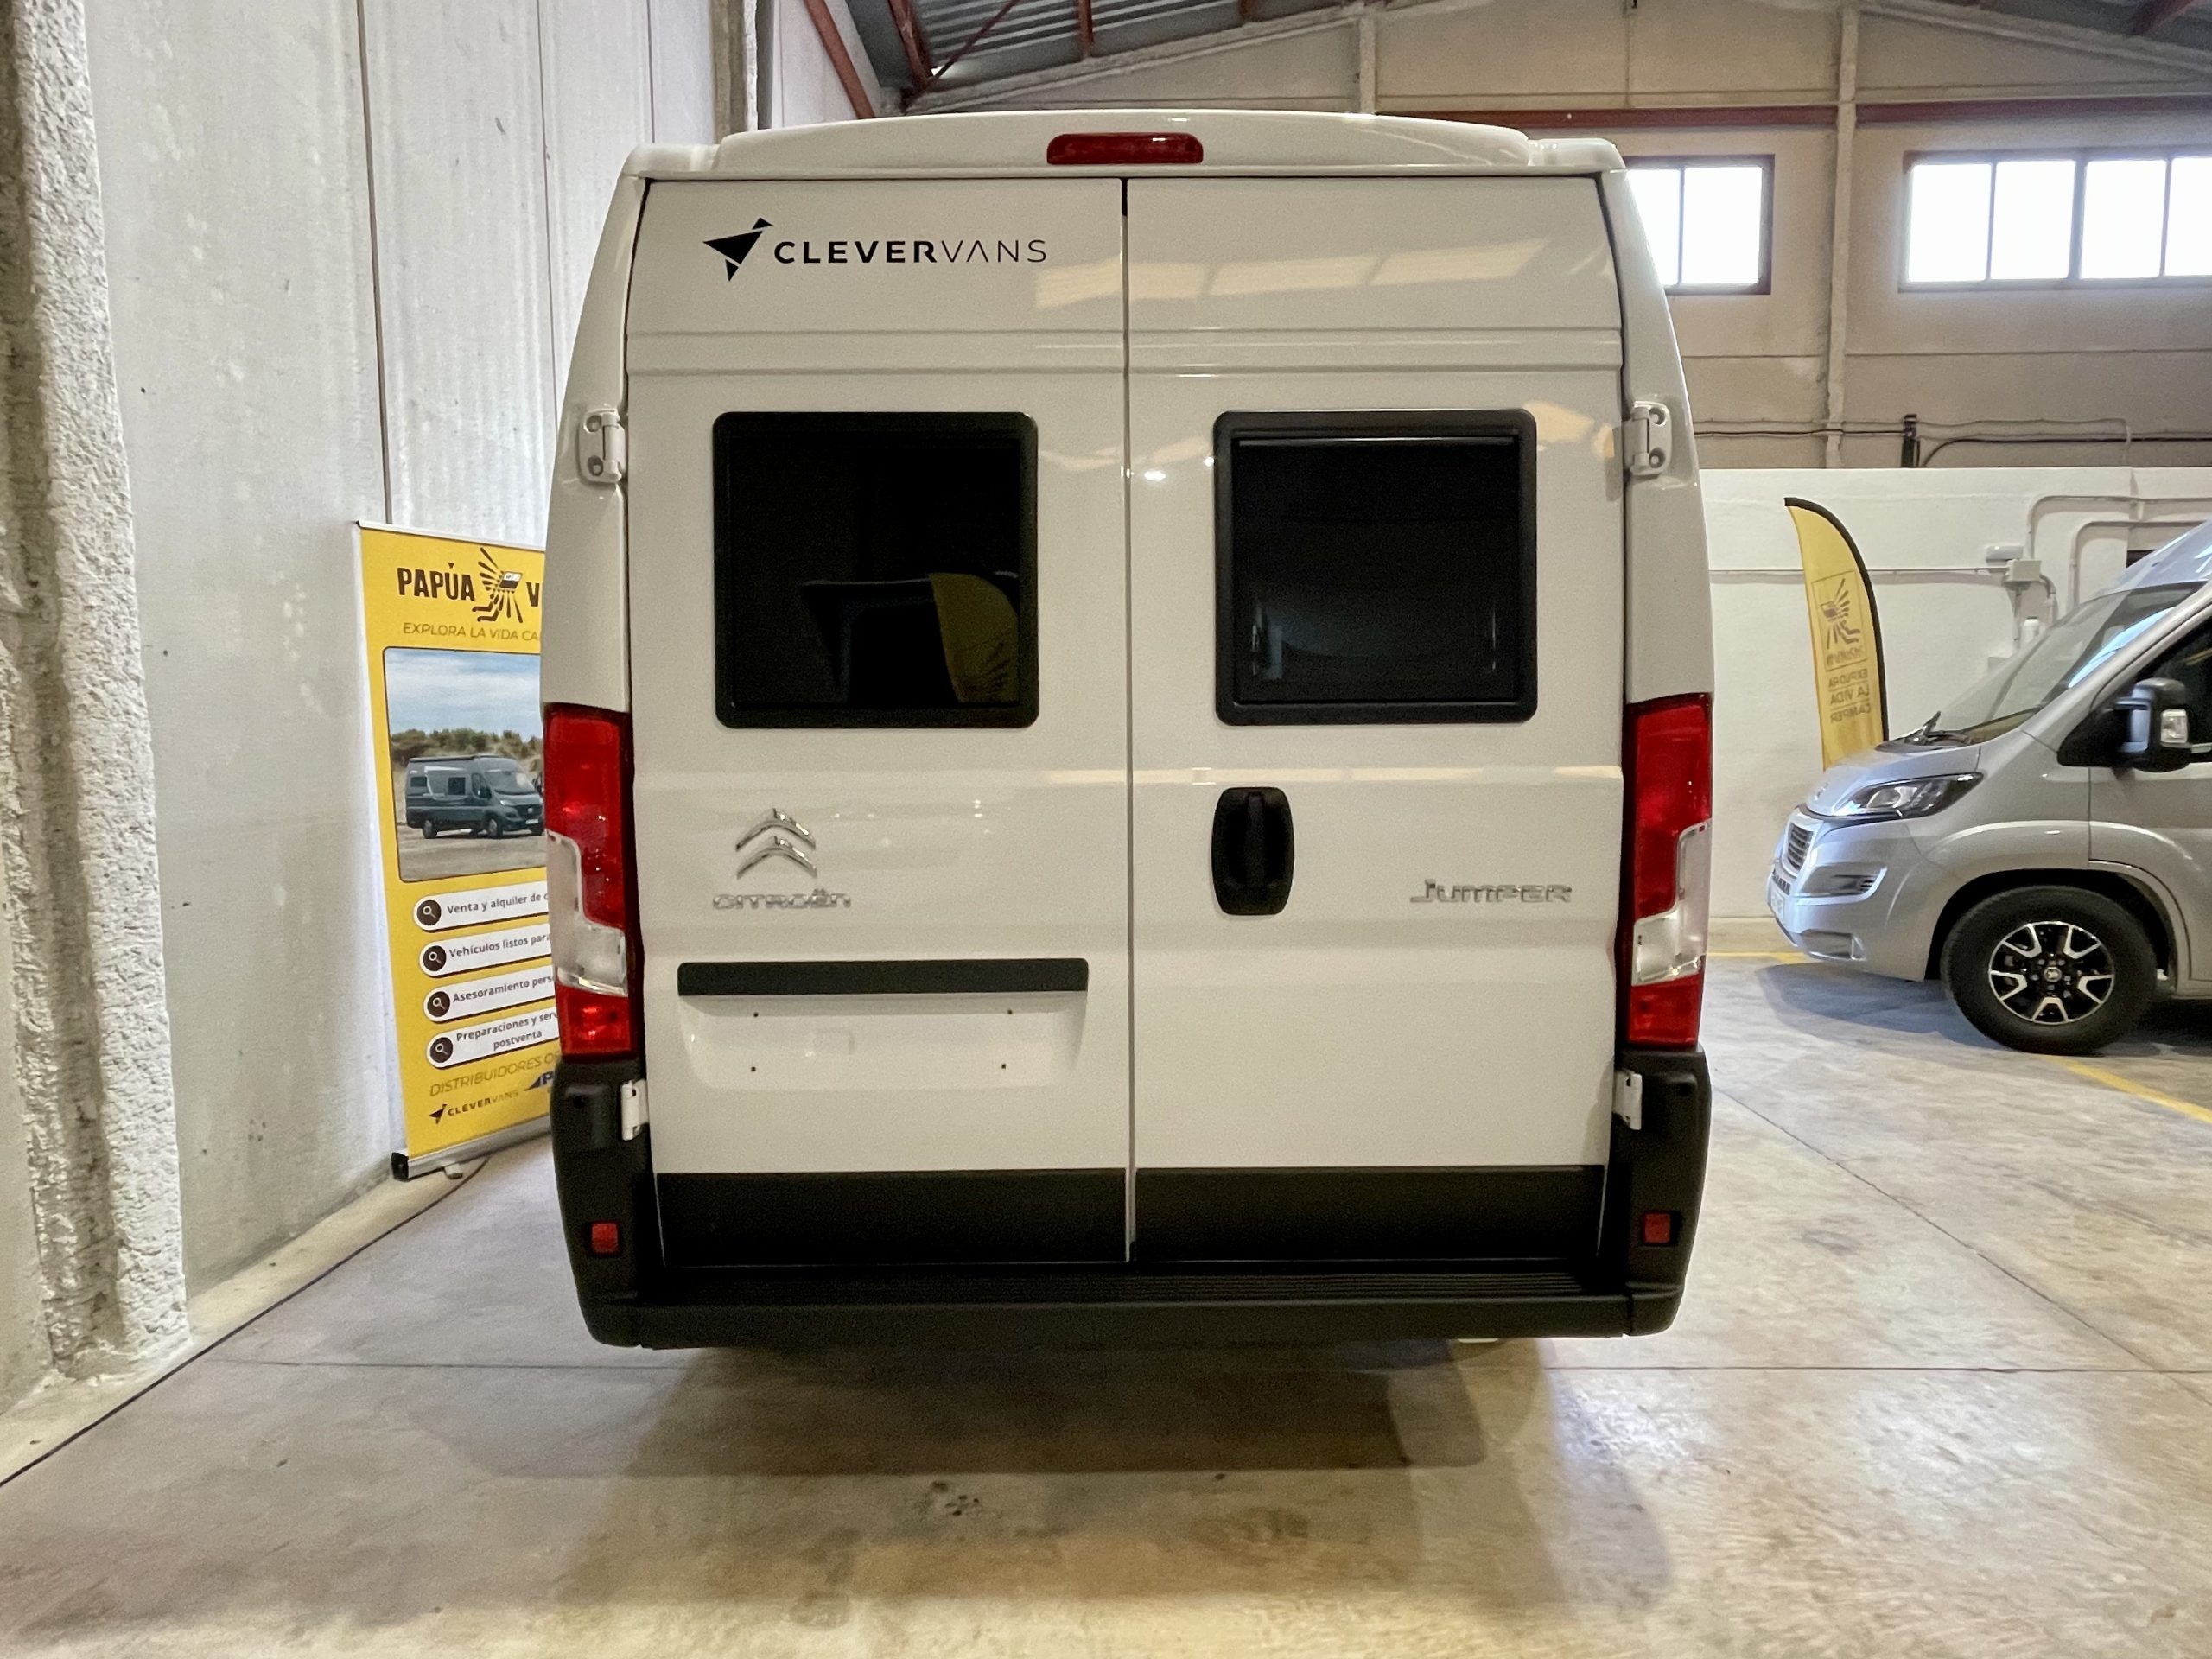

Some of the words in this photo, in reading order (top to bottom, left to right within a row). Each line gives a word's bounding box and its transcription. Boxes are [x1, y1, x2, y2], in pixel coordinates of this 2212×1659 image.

[773, 239, 1047, 264] CLEVERVANS
[397, 562, 476, 602] PAPÚA
[403, 621, 467, 638] EXPLORA
[469, 628, 486, 639] LA
[489, 628, 519, 641] VIDA
[521, 629, 540, 642] CA
[447, 902, 479, 914] Venta
[480, 901, 488, 912] y
[490, 895, 528, 909] alquiler
[530, 893, 542, 903] de
[448, 941, 500, 958] Vehículos
[503, 935, 529, 949] listos
[453, 981, 531, 1003] Asesoramiento
[532, 975, 554, 988] pers
[456, 1016, 529, 1042] Preparaciones
[531, 1015, 538, 1026] y
[493, 1029, 543, 1052] postventa
[429, 1058, 541, 1097] DISTRIBUIDORES
[448, 1090, 519, 1116] CLEVERVANS
